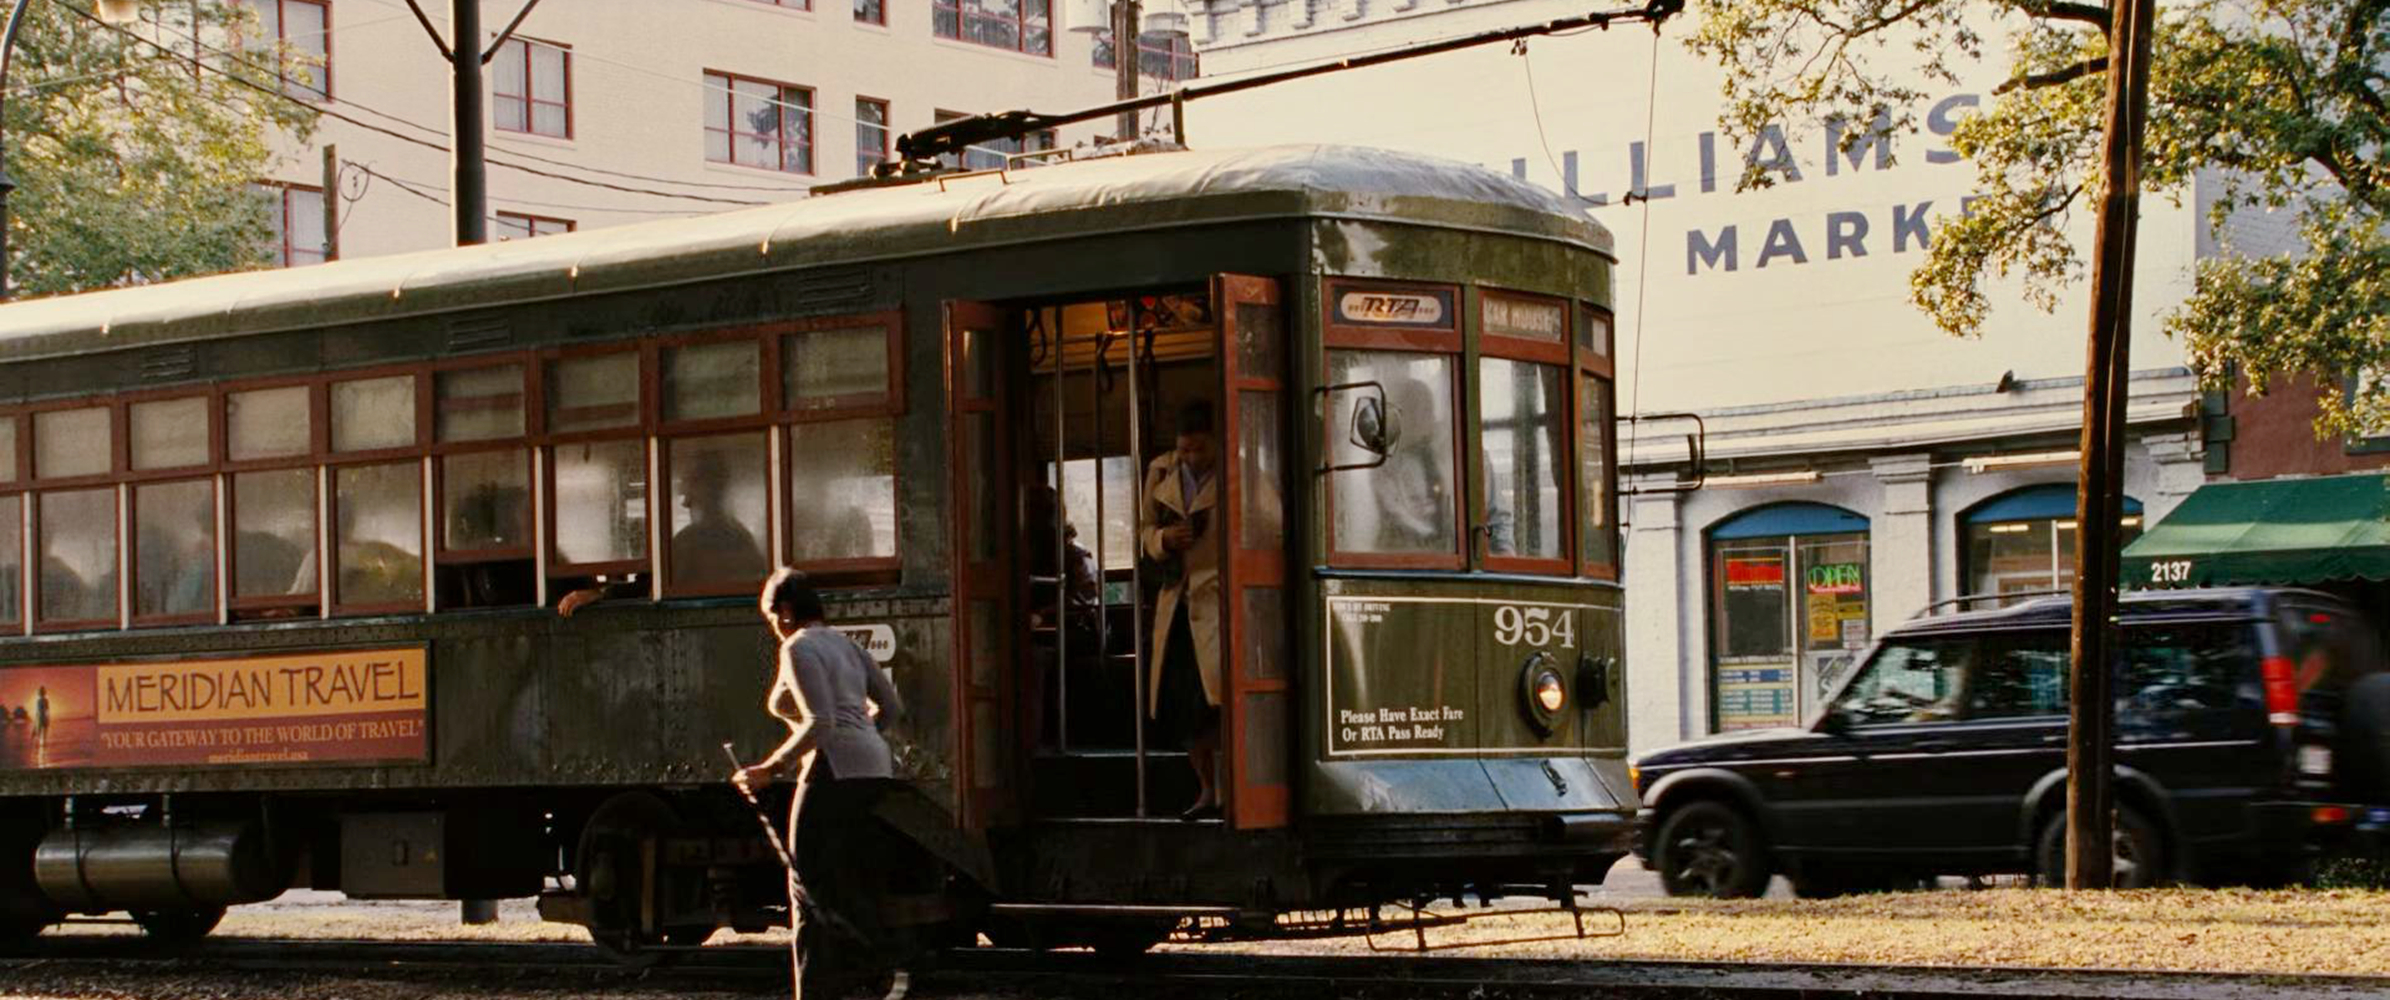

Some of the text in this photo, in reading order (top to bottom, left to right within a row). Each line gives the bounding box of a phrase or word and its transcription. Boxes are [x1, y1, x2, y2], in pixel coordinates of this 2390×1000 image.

[1472, 92, 1980, 211] LLIAMS
[1686, 193, 2050, 276] MARK
[1361, 296, 1420, 314] RTA
[1807, 564, 1861, 588] OPEN
[2151, 561, 2191, 582] 2137
[1494, 606, 1575, 649] 954
[106, 661, 420, 714] MERIDIAN TRAVEL
[1341, 706, 1463, 724] Please Have Exact Fare
[147, 728, 218, 748] GATEWAY
[219, 728, 241, 746] TO
[244, 726, 274, 744] THE
[276, 723, 333, 743] WORLD
[335, 722, 356, 740] OF
[1342, 725, 1444, 742] Or RTA Pass Ready
